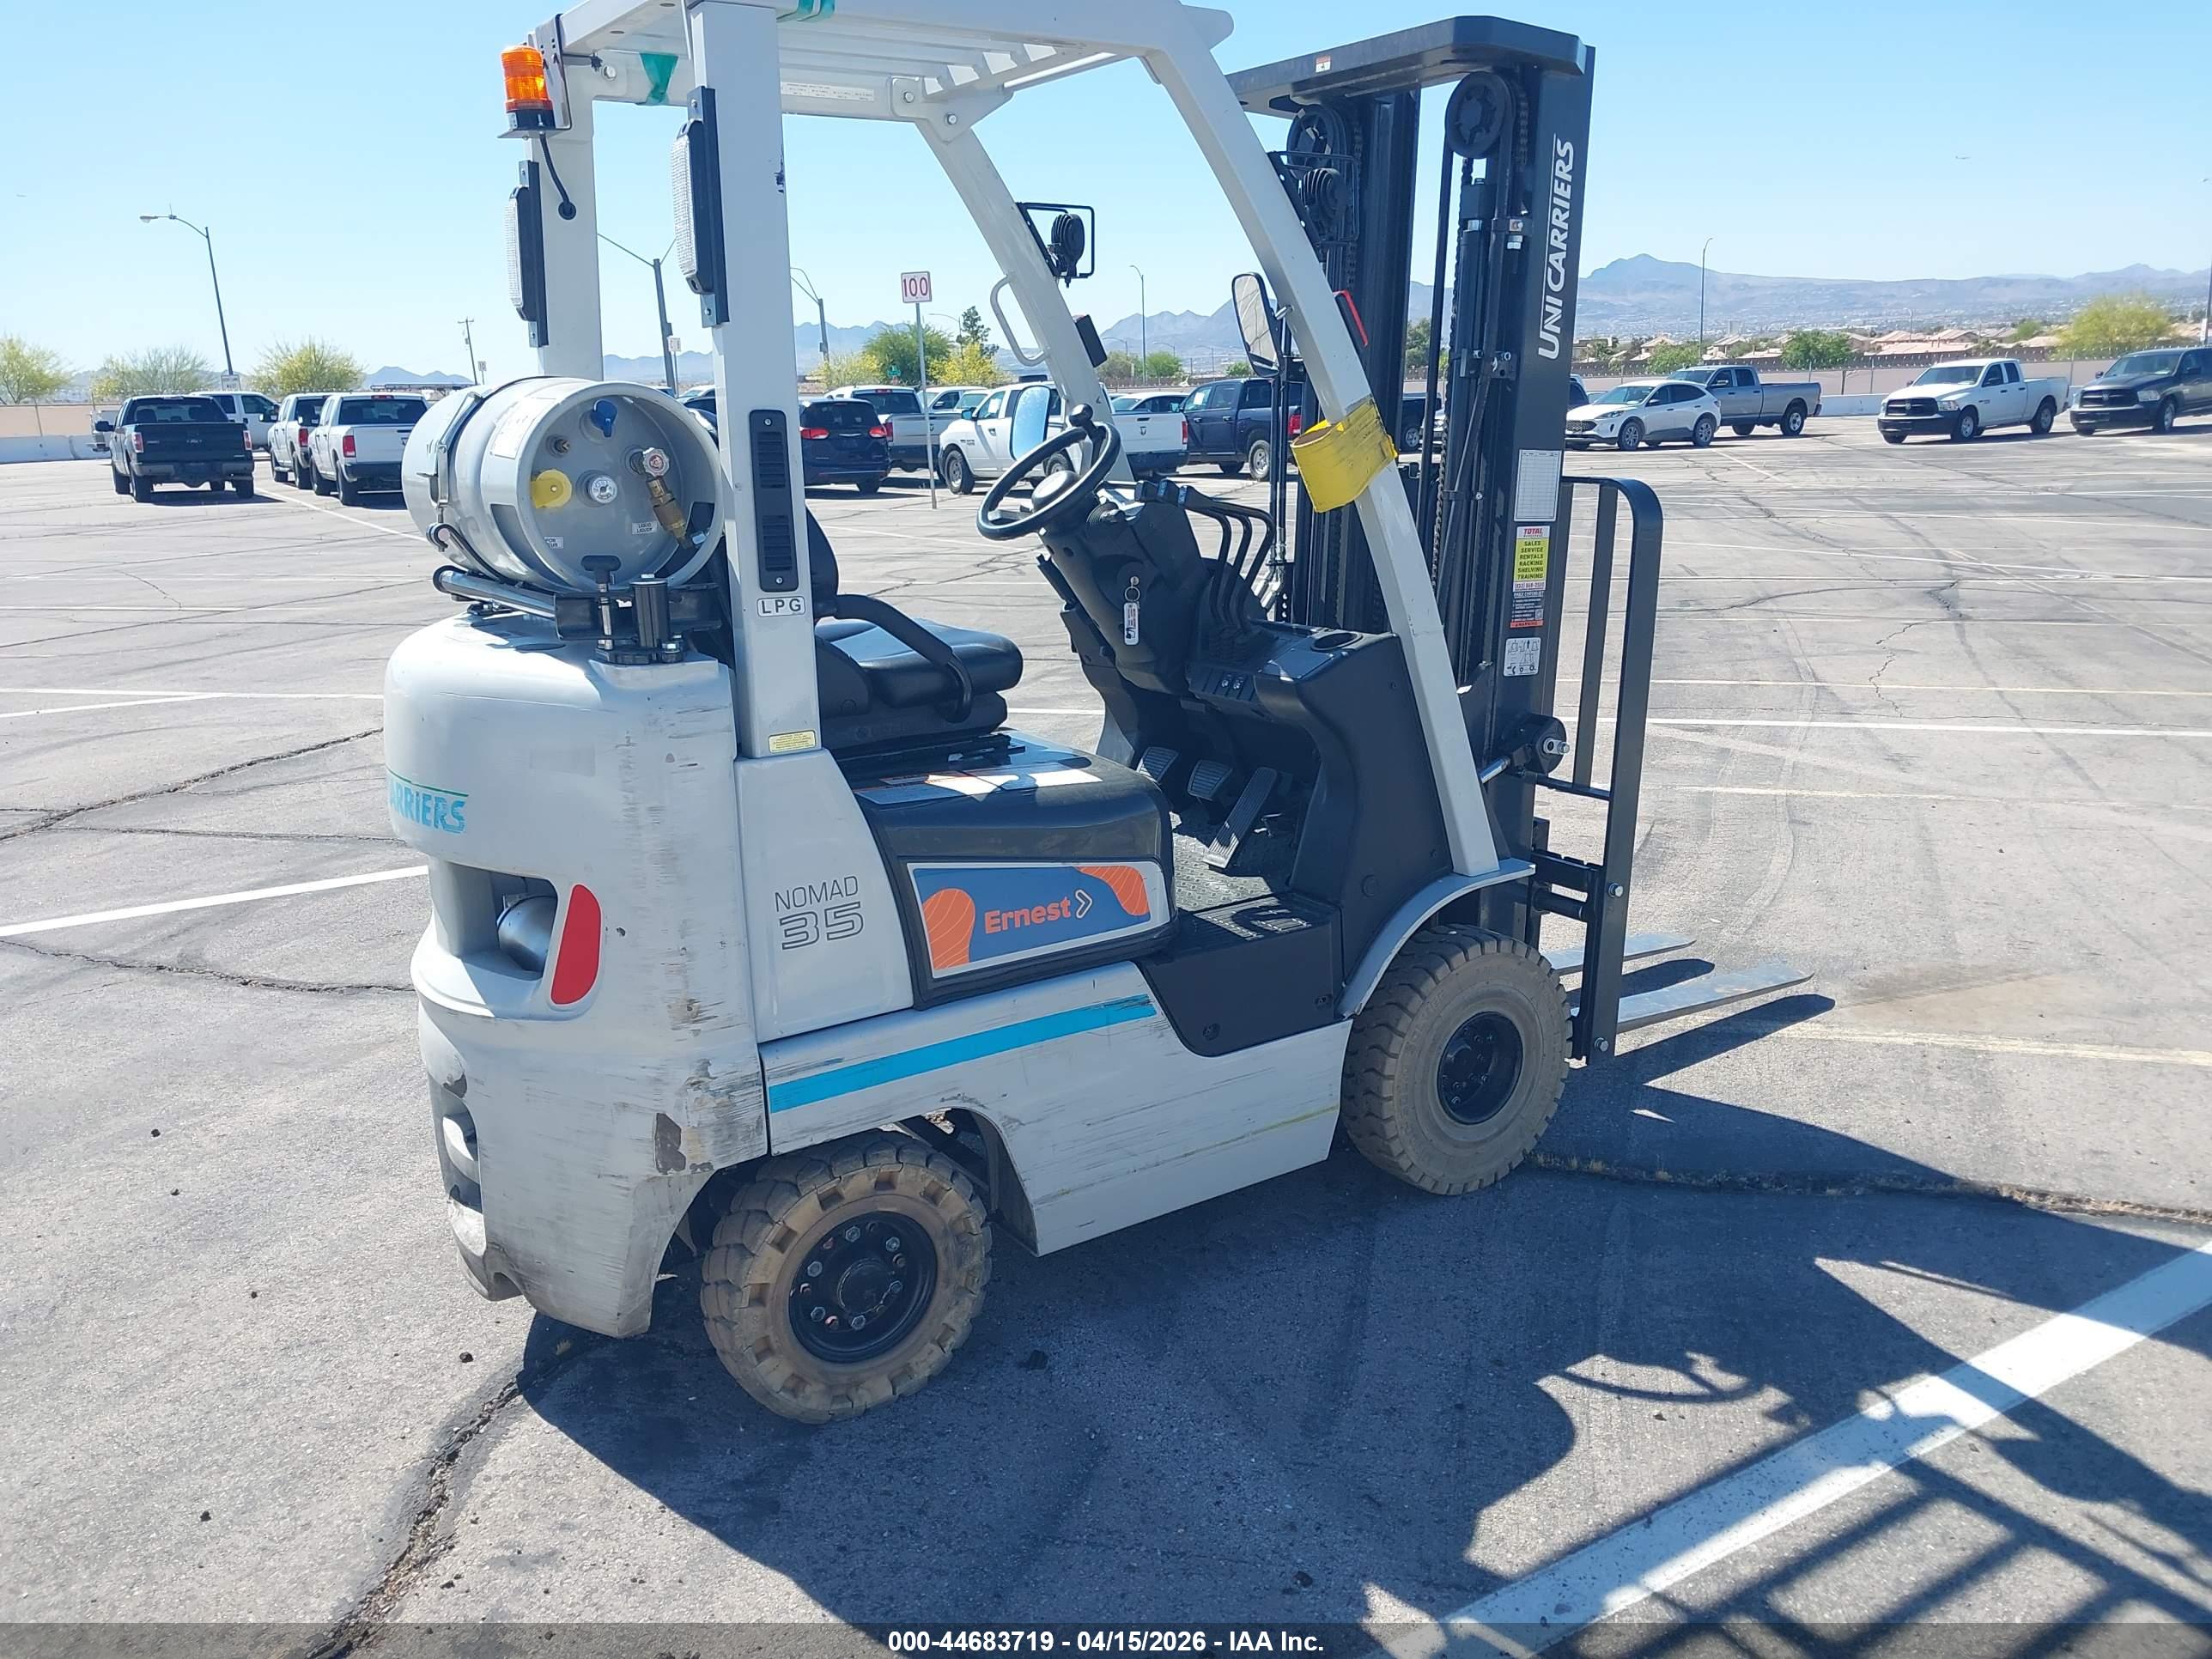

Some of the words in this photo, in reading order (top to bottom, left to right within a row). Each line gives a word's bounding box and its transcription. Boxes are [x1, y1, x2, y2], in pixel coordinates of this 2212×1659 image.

[902, 276, 928, 297] 100
[761, 598, 801, 614] LPG
[775, 876, 859, 912] NOMAD
[779, 901, 864, 951] 35
[984, 896, 1072, 934] Ernest
